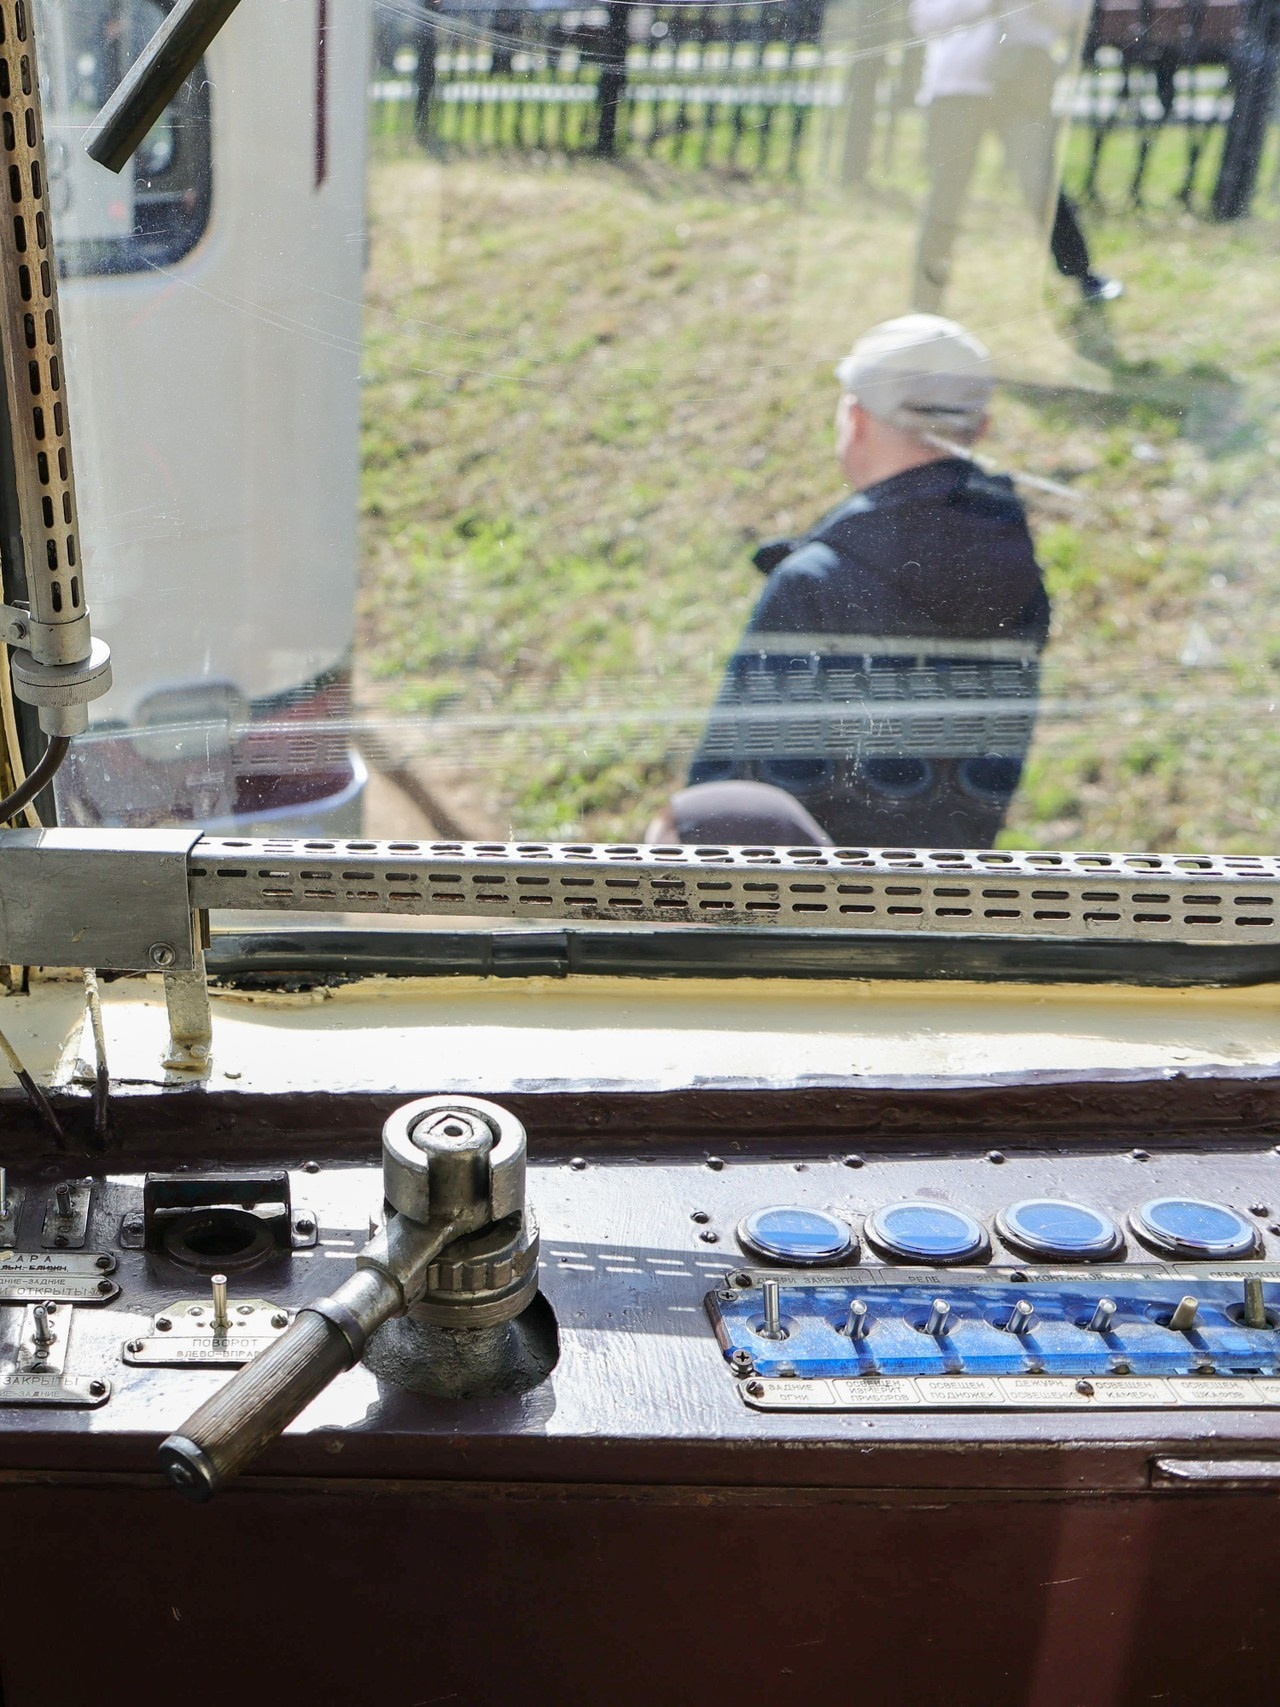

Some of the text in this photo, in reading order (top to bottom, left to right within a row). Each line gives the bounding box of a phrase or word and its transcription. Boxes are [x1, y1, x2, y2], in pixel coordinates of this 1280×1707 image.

[0, 1255, 52, 1263] АРА
[804, 1276, 863, 1284] ЗАКРЫТЫ
[17, 1286, 91, 1296] ОТКРЫТЫ
[192, 1338, 259, 1347] ПОВОРОТ
[5, 1376, 79, 1386] ЗАКРЫТЫ
[1015, 1380, 1068, 1388] ДЕЖУРН.
[768, 1383, 814, 1391] ЗАДНИЕ
[779, 1393, 810, 1401] ОГНИ
[930, 1391, 996, 1400] ПОДНОЖЕК
[1106, 1391, 1159, 1399] КАМЕРЫ
[1192, 1391, 1245, 1399] ШКАФОВ
